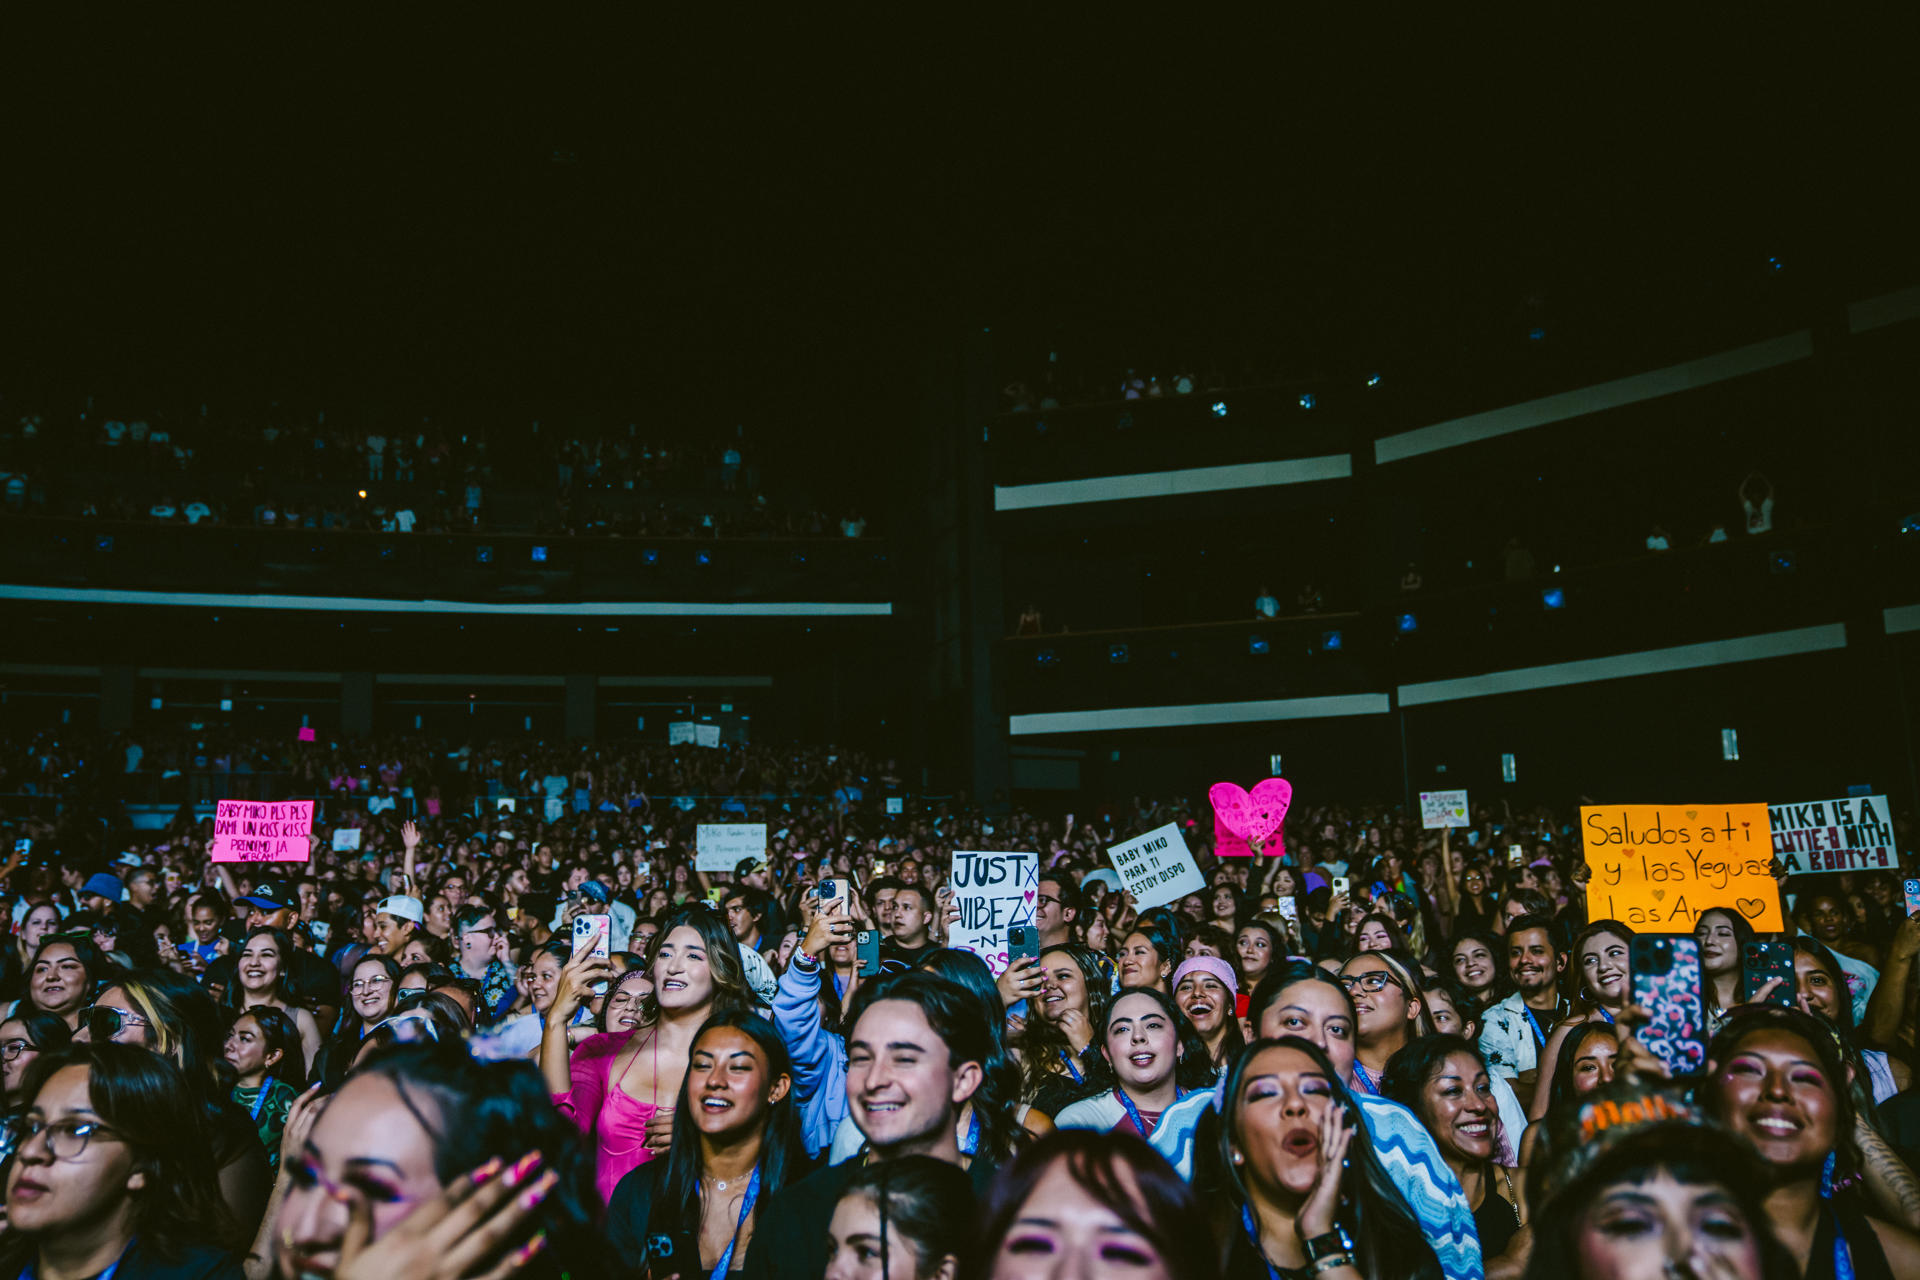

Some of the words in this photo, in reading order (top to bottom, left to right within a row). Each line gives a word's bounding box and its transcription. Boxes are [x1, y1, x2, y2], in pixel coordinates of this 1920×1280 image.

[219, 803, 243, 818] BABY
[243, 804, 266, 819] MIKO
[270, 805, 285, 820] PLS
[290, 805, 307, 820] PLS
[1768, 803, 1827, 831] MIKO
[1832, 801, 1854, 825] IS
[1860, 799, 1880, 824] A
[242, 821, 257, 836] UN
[259, 822, 279, 838] KISS
[282, 822, 306, 838] KISS
[1587, 811, 1690, 846] Saludos
[1701, 826, 1715, 843] a
[1721, 811, 1751, 842] ti
[1771, 827, 1841, 853] CUTIE-O
[1844, 823, 1891, 848] WITH
[275, 840, 288, 857] LA
[1116, 847, 1140, 866] BABY
[1142, 837, 1168, 855] MIKO
[1784, 854, 1802, 872] A
[1809, 847, 1889, 870] BOOTY-O
[954, 854, 1028, 888] JUST
[1123, 863, 1147, 880] PARA
[1150, 857, 1160, 869] TI
[1130, 875, 1158, 896] ESTOY
[1159, 862, 1186, 883] DISPO
[1603, 863, 1621, 886] y
[1642, 855, 1685, 882] las
[1686, 849, 1772, 889] Yeguas
[956, 896, 1029, 930] VIBEZ
